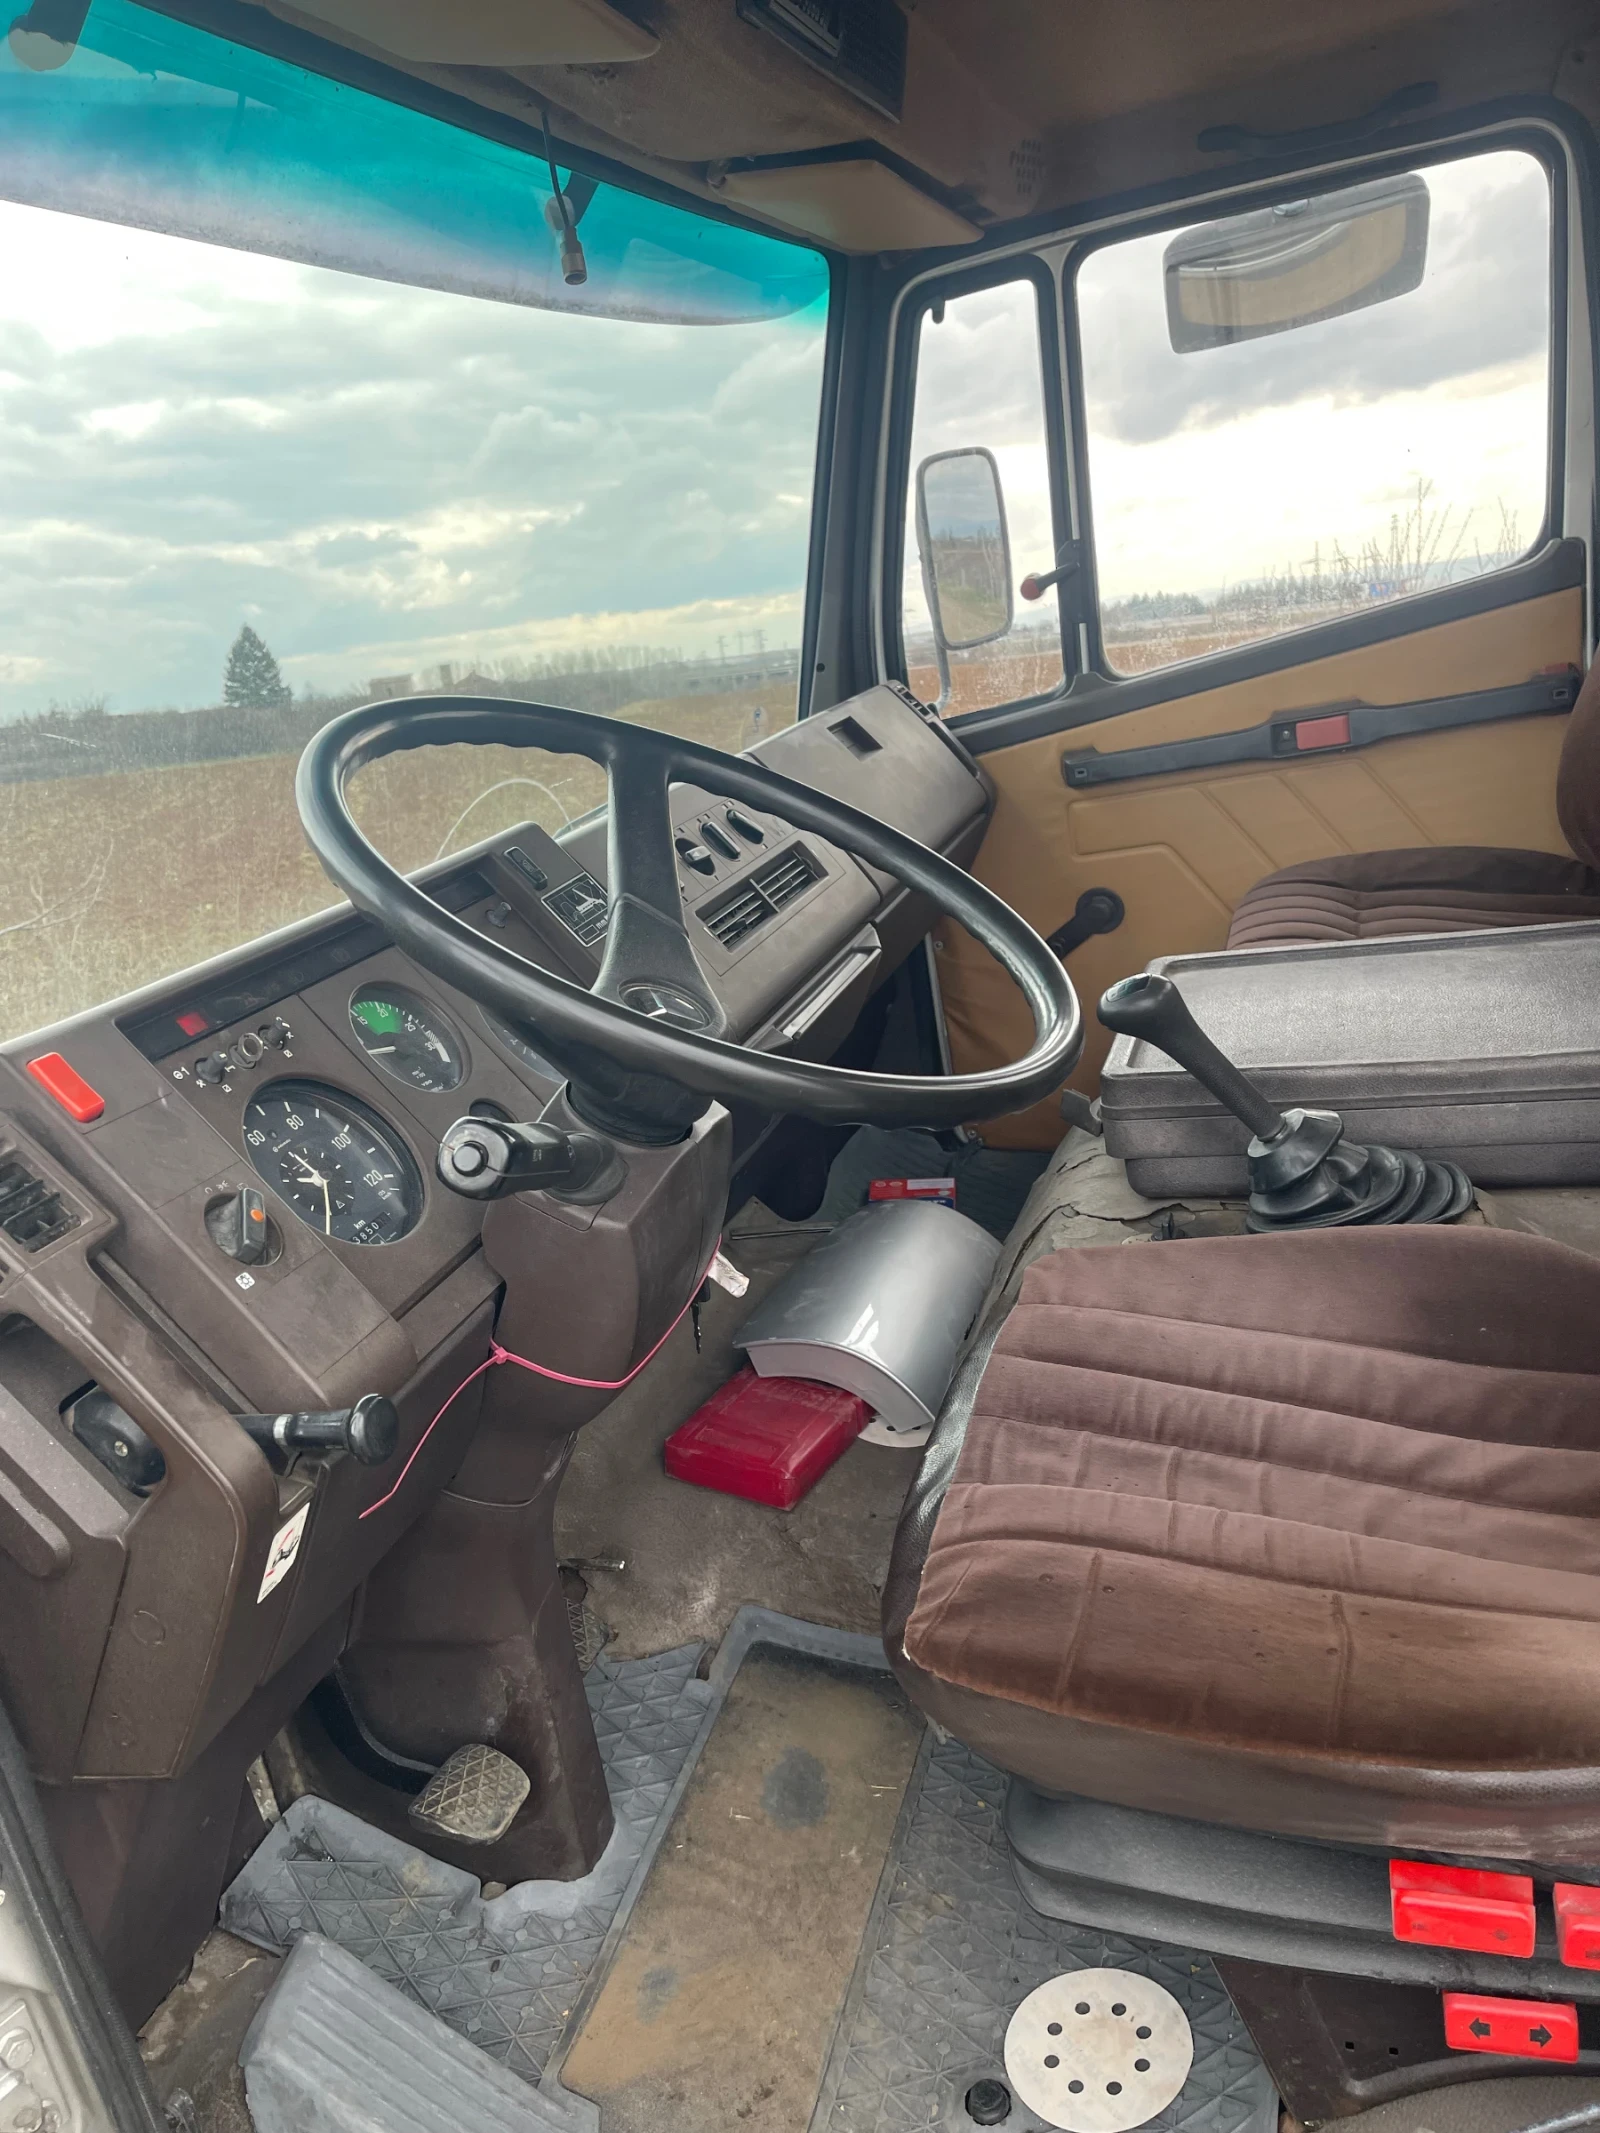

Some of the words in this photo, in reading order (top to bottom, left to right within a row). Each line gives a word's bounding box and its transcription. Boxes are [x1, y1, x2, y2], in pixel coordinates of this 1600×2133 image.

[357, 1016, 368, 1026] 15
[425, 1041, 436, 1051] 30
[286, 1114, 305, 1131] 80
[247, 1129, 266, 1146] 60
[331, 1132, 352, 1151] 100
[363, 1169, 383, 1188] 120
[353, 1219, 366, 1230] km
